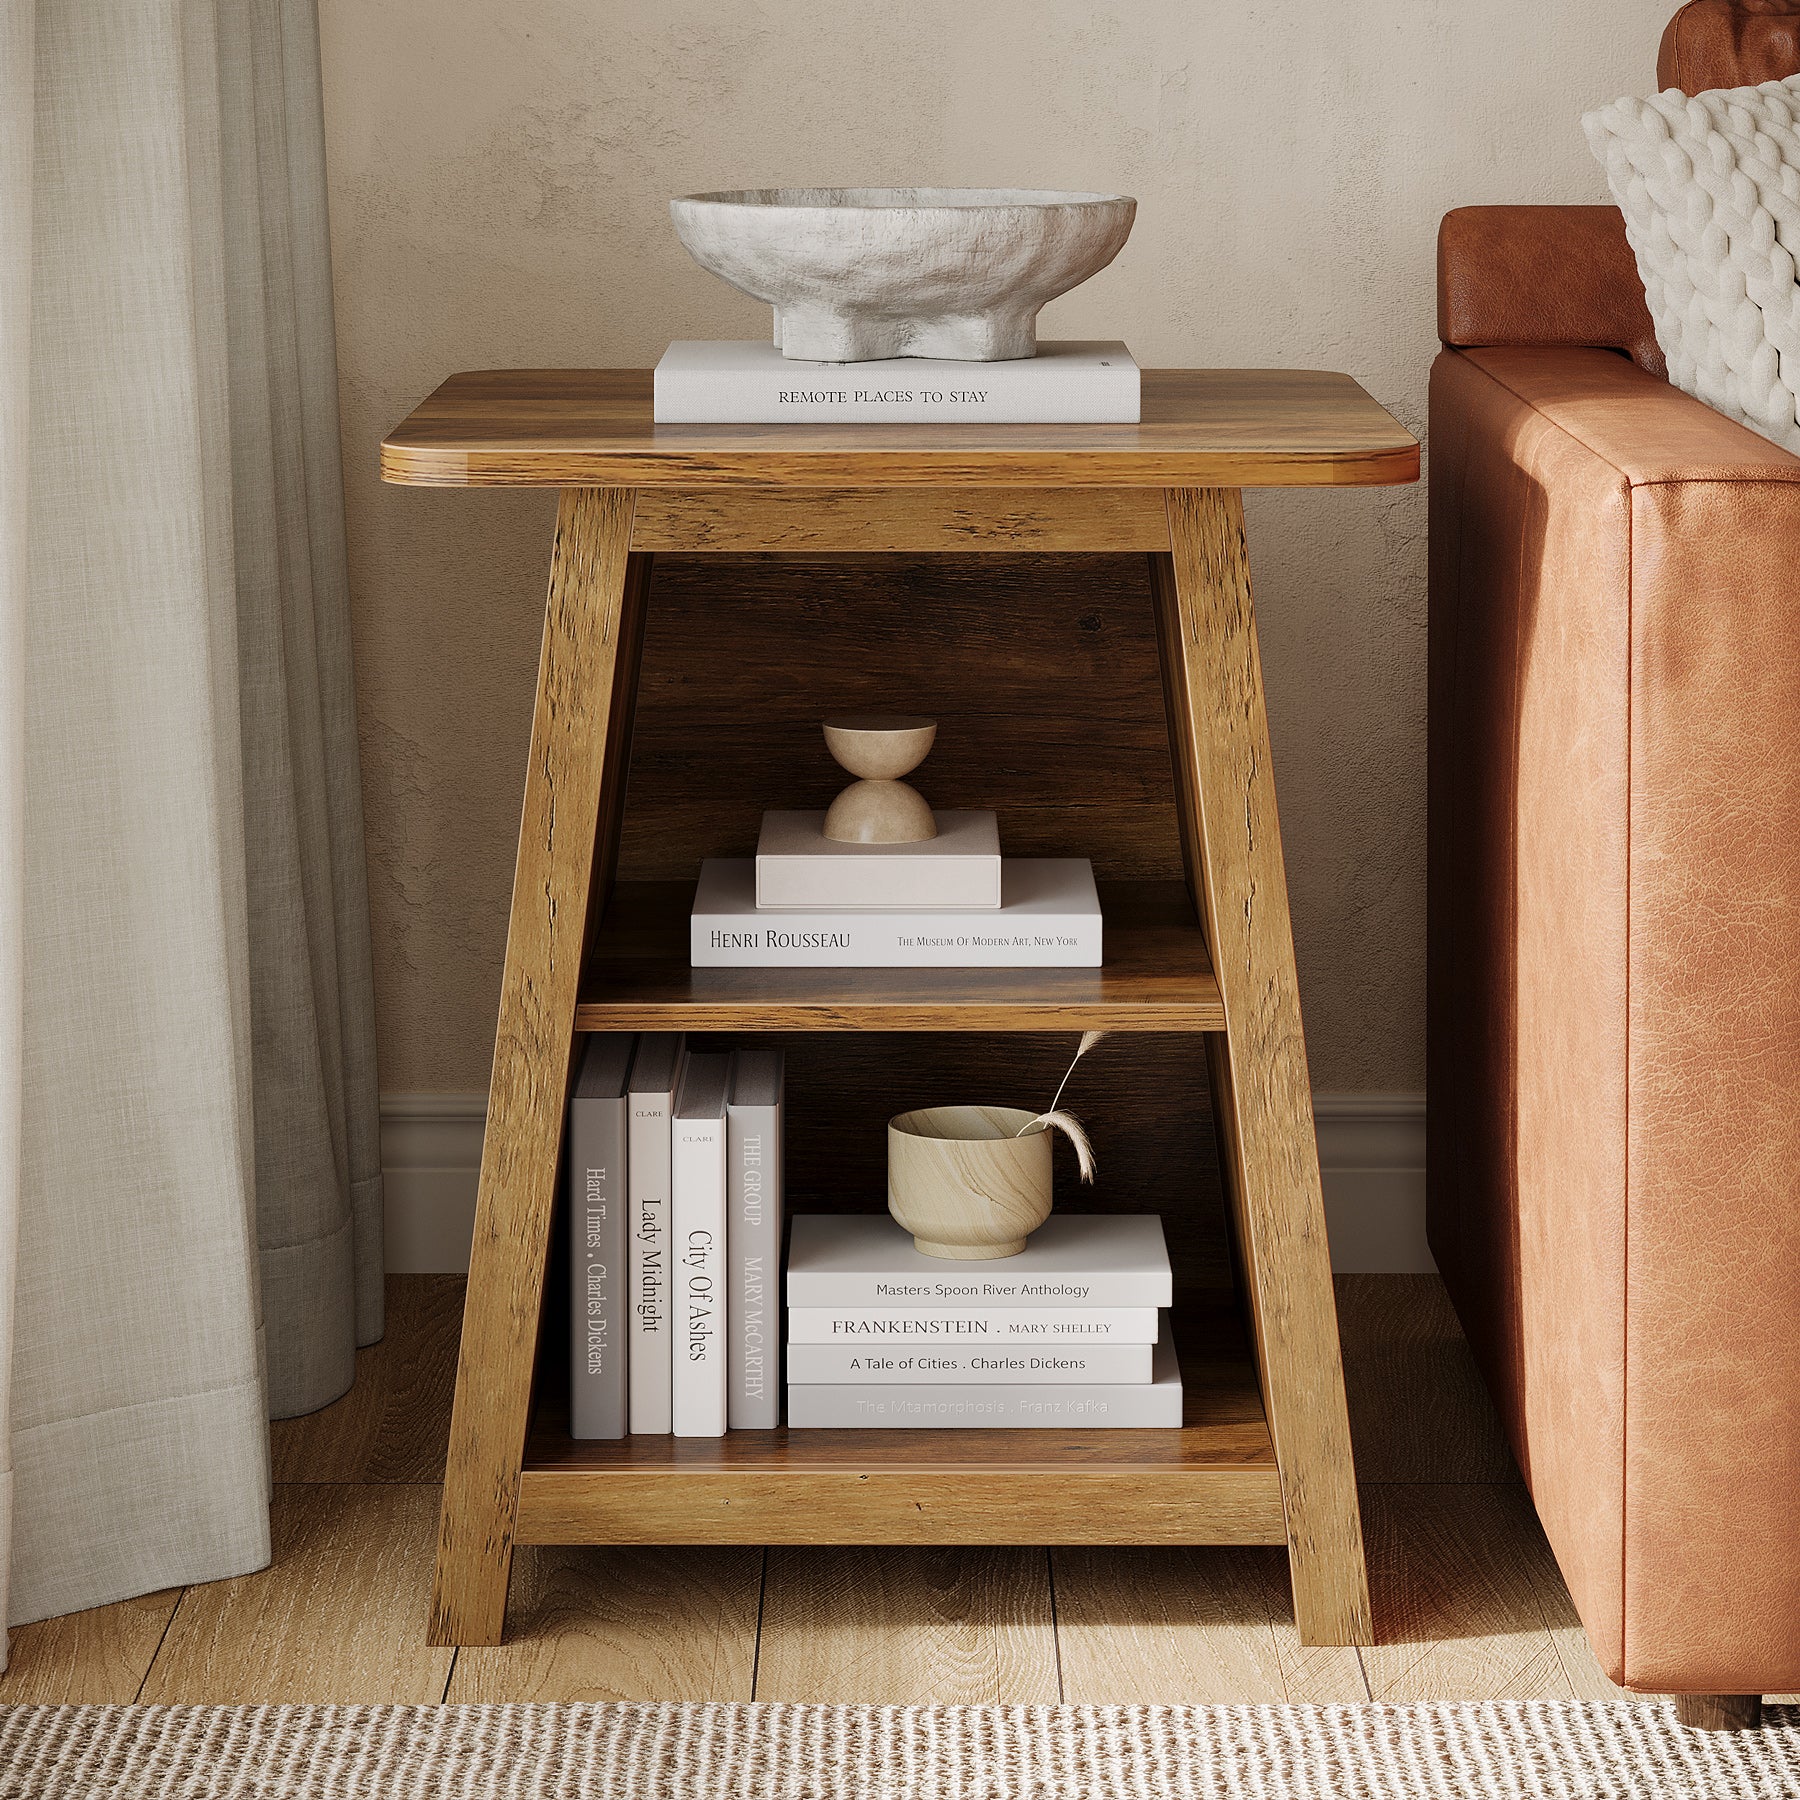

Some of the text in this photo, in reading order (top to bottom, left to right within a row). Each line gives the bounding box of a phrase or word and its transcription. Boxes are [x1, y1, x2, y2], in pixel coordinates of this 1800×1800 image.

[778, 390, 989, 404] REMOTE PLACES TO STAY
[635, 1110, 664, 1118] CLARE
[586, 1167, 607, 1202] Hard
[743, 1134, 762, 1227] THE GROUP
[586, 1204, 607, 1248] Times
[636, 1198, 663, 1333] Lady Midnight
[586, 1263, 608, 1316] Charles
[682, 1230, 714, 1362] City Of Ashes
[876, 1283, 1090, 1299] Masters Spoon River Anthology
[587, 1318, 608, 1375] Dickens
[744, 1256, 764, 1401] MARY McCARTHY
[831, 1320, 989, 1334] FRANKENSTEIN
[1008, 1323, 1049, 1334] MARY
[1052, 1323, 1112, 1334] SHELLEY
[849, 1358, 861, 1370] A
[864, 1357, 894, 1370] Tale
[898, 1357, 915, 1370] of
[917, 1357, 958, 1370] Cities
[970, 1357, 1026, 1370] Charles
[1030, 1356, 1086, 1370] Dickens
[856, 1400, 885, 1413] The
[1019, 1400, 1062, 1413] Franz
[1066, 1400, 1109, 1413] Kafka
